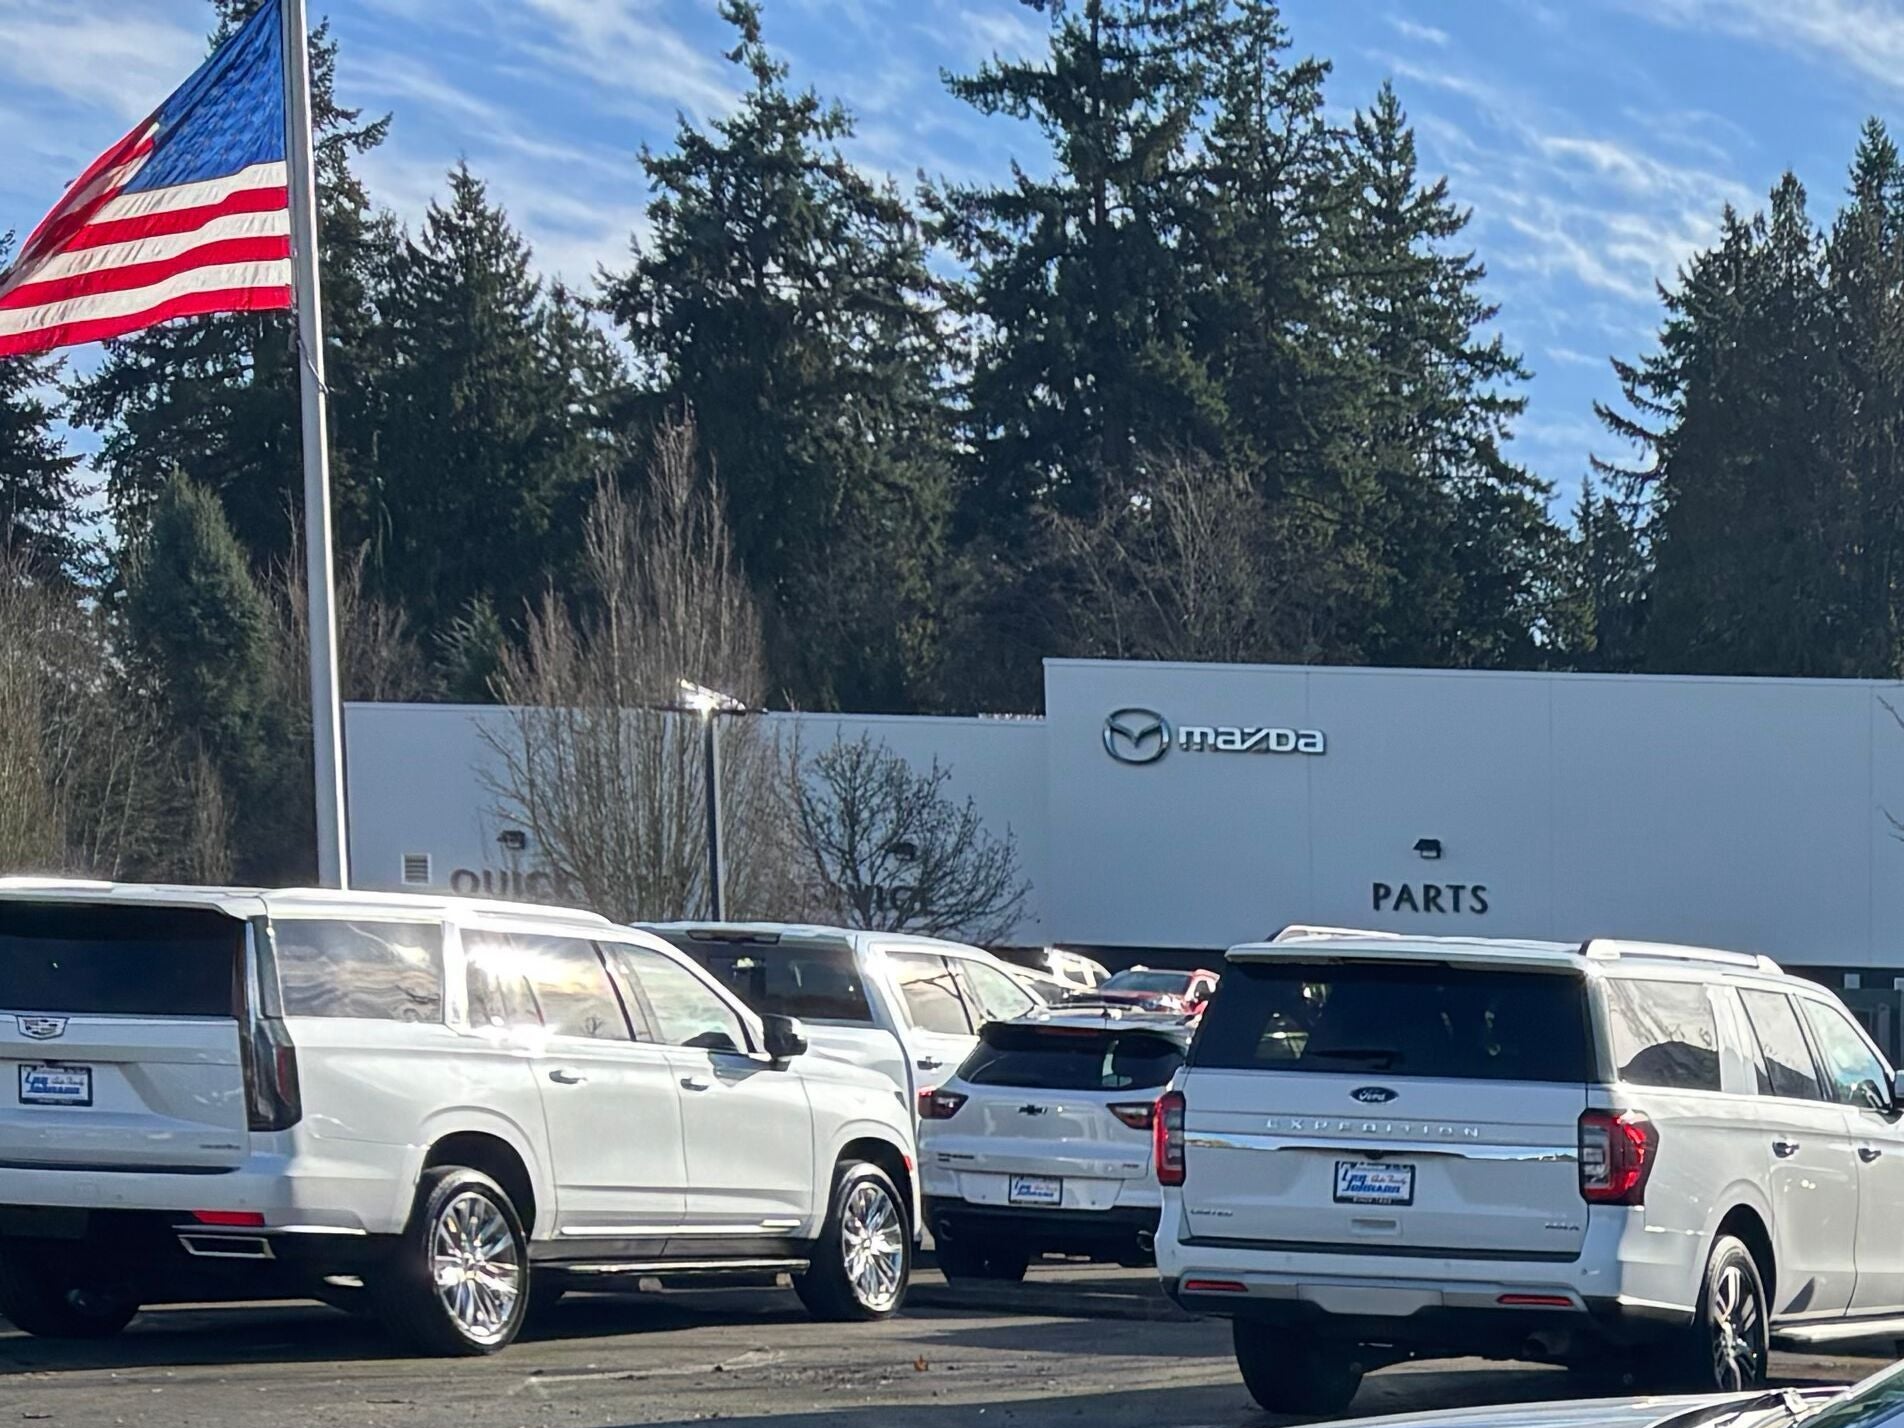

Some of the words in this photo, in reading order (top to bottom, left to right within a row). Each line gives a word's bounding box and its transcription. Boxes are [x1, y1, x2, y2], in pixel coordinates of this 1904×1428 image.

[1178, 726, 1326, 754] mazda
[1372, 882, 1489, 914] PARTS
[1266, 1119, 1479, 1138] EXPEDITION
